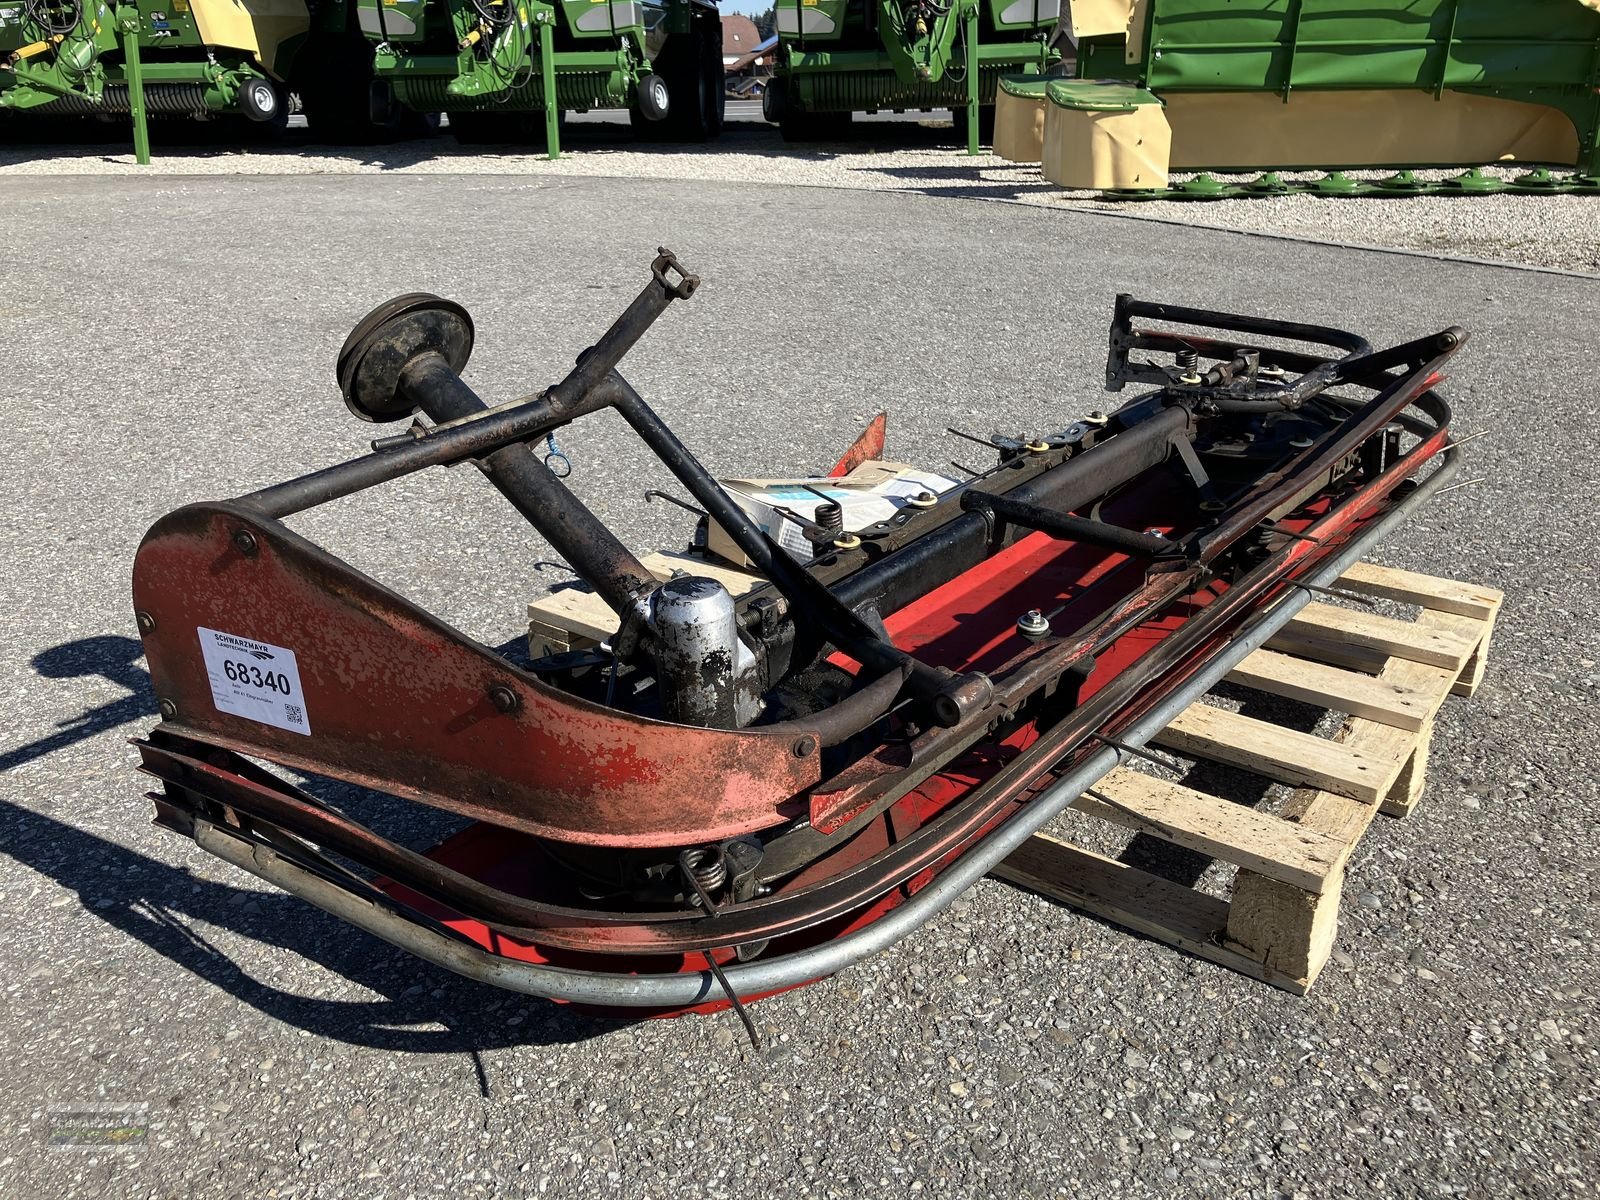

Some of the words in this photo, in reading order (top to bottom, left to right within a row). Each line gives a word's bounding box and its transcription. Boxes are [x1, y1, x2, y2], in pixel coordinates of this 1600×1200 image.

[214, 634, 268, 652] SCHWARZMAYR
[217, 642, 248, 653] LANDTECHNIK
[224, 660, 290, 695] 68340
